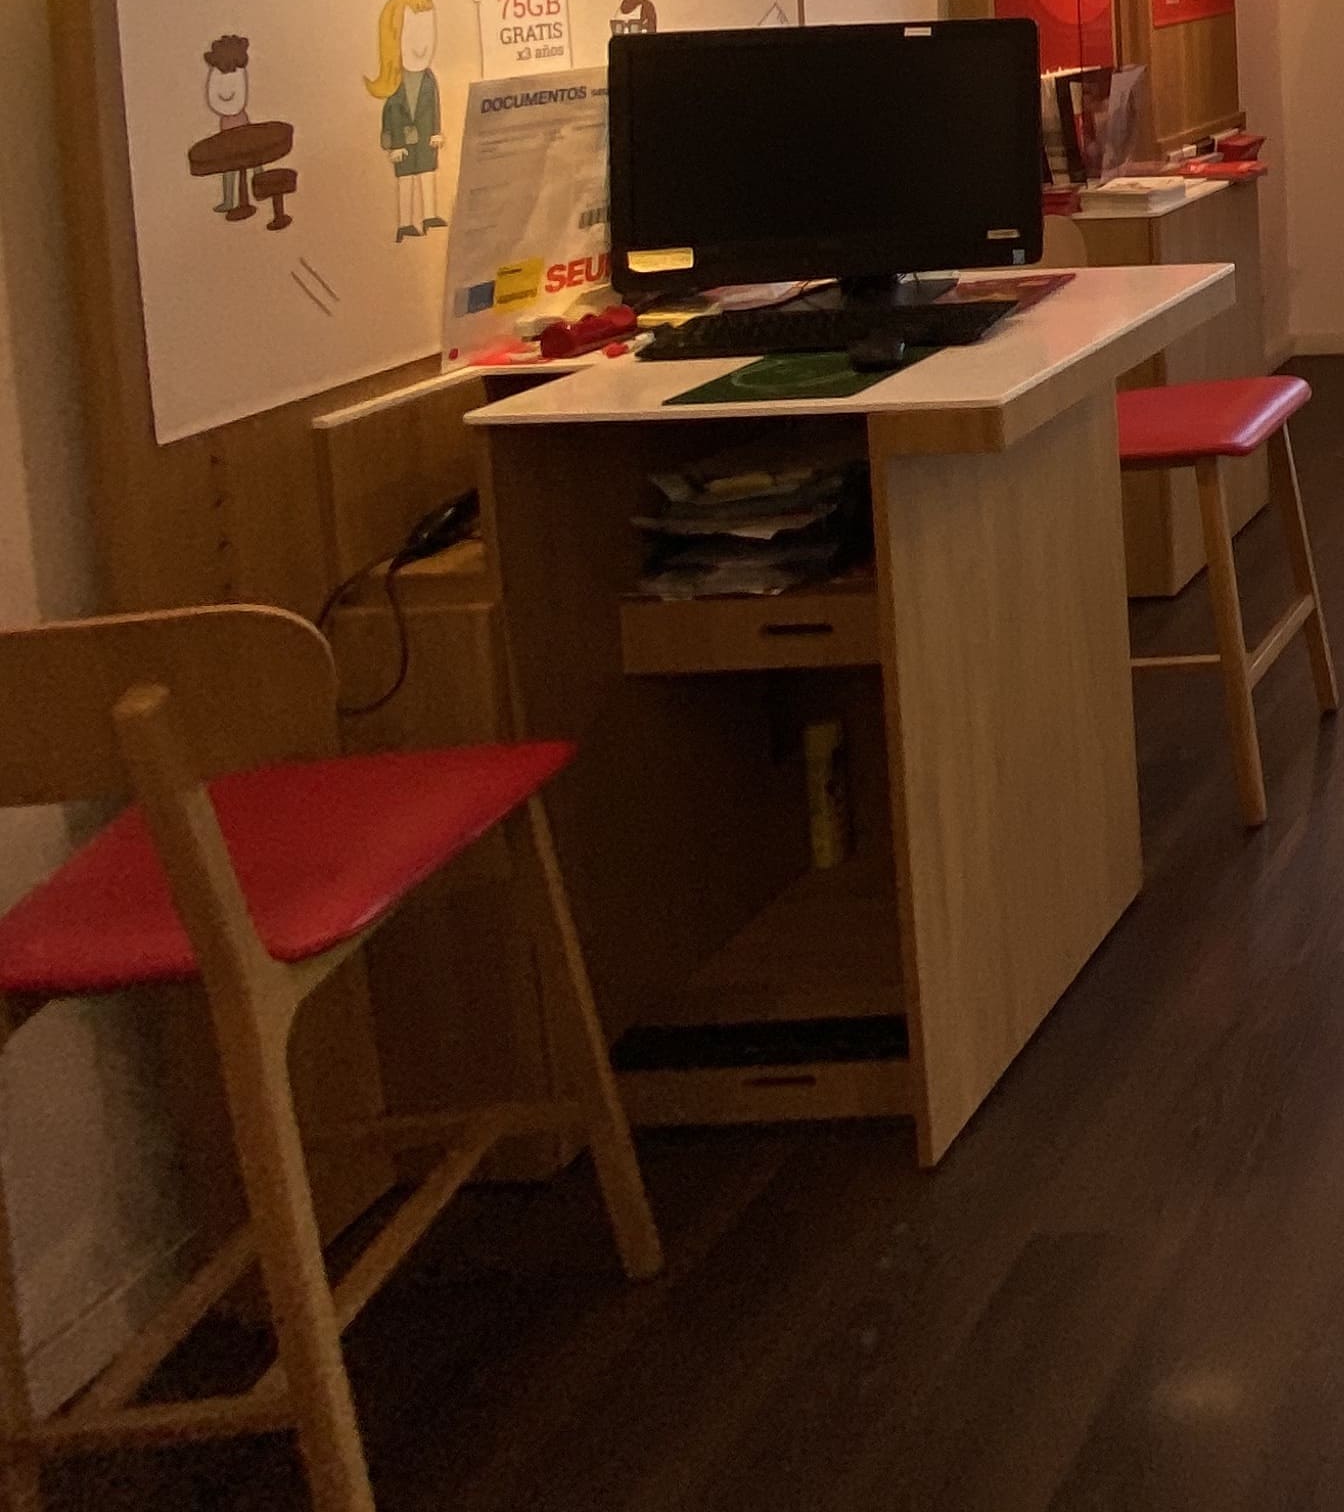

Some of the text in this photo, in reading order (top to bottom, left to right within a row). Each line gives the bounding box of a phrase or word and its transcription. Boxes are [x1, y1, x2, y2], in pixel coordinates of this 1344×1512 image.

[500, 22, 563, 44] GRATIS
[516, 45, 564, 61] x3 años
[481, 86, 587, 114] DOCUMENTOS
